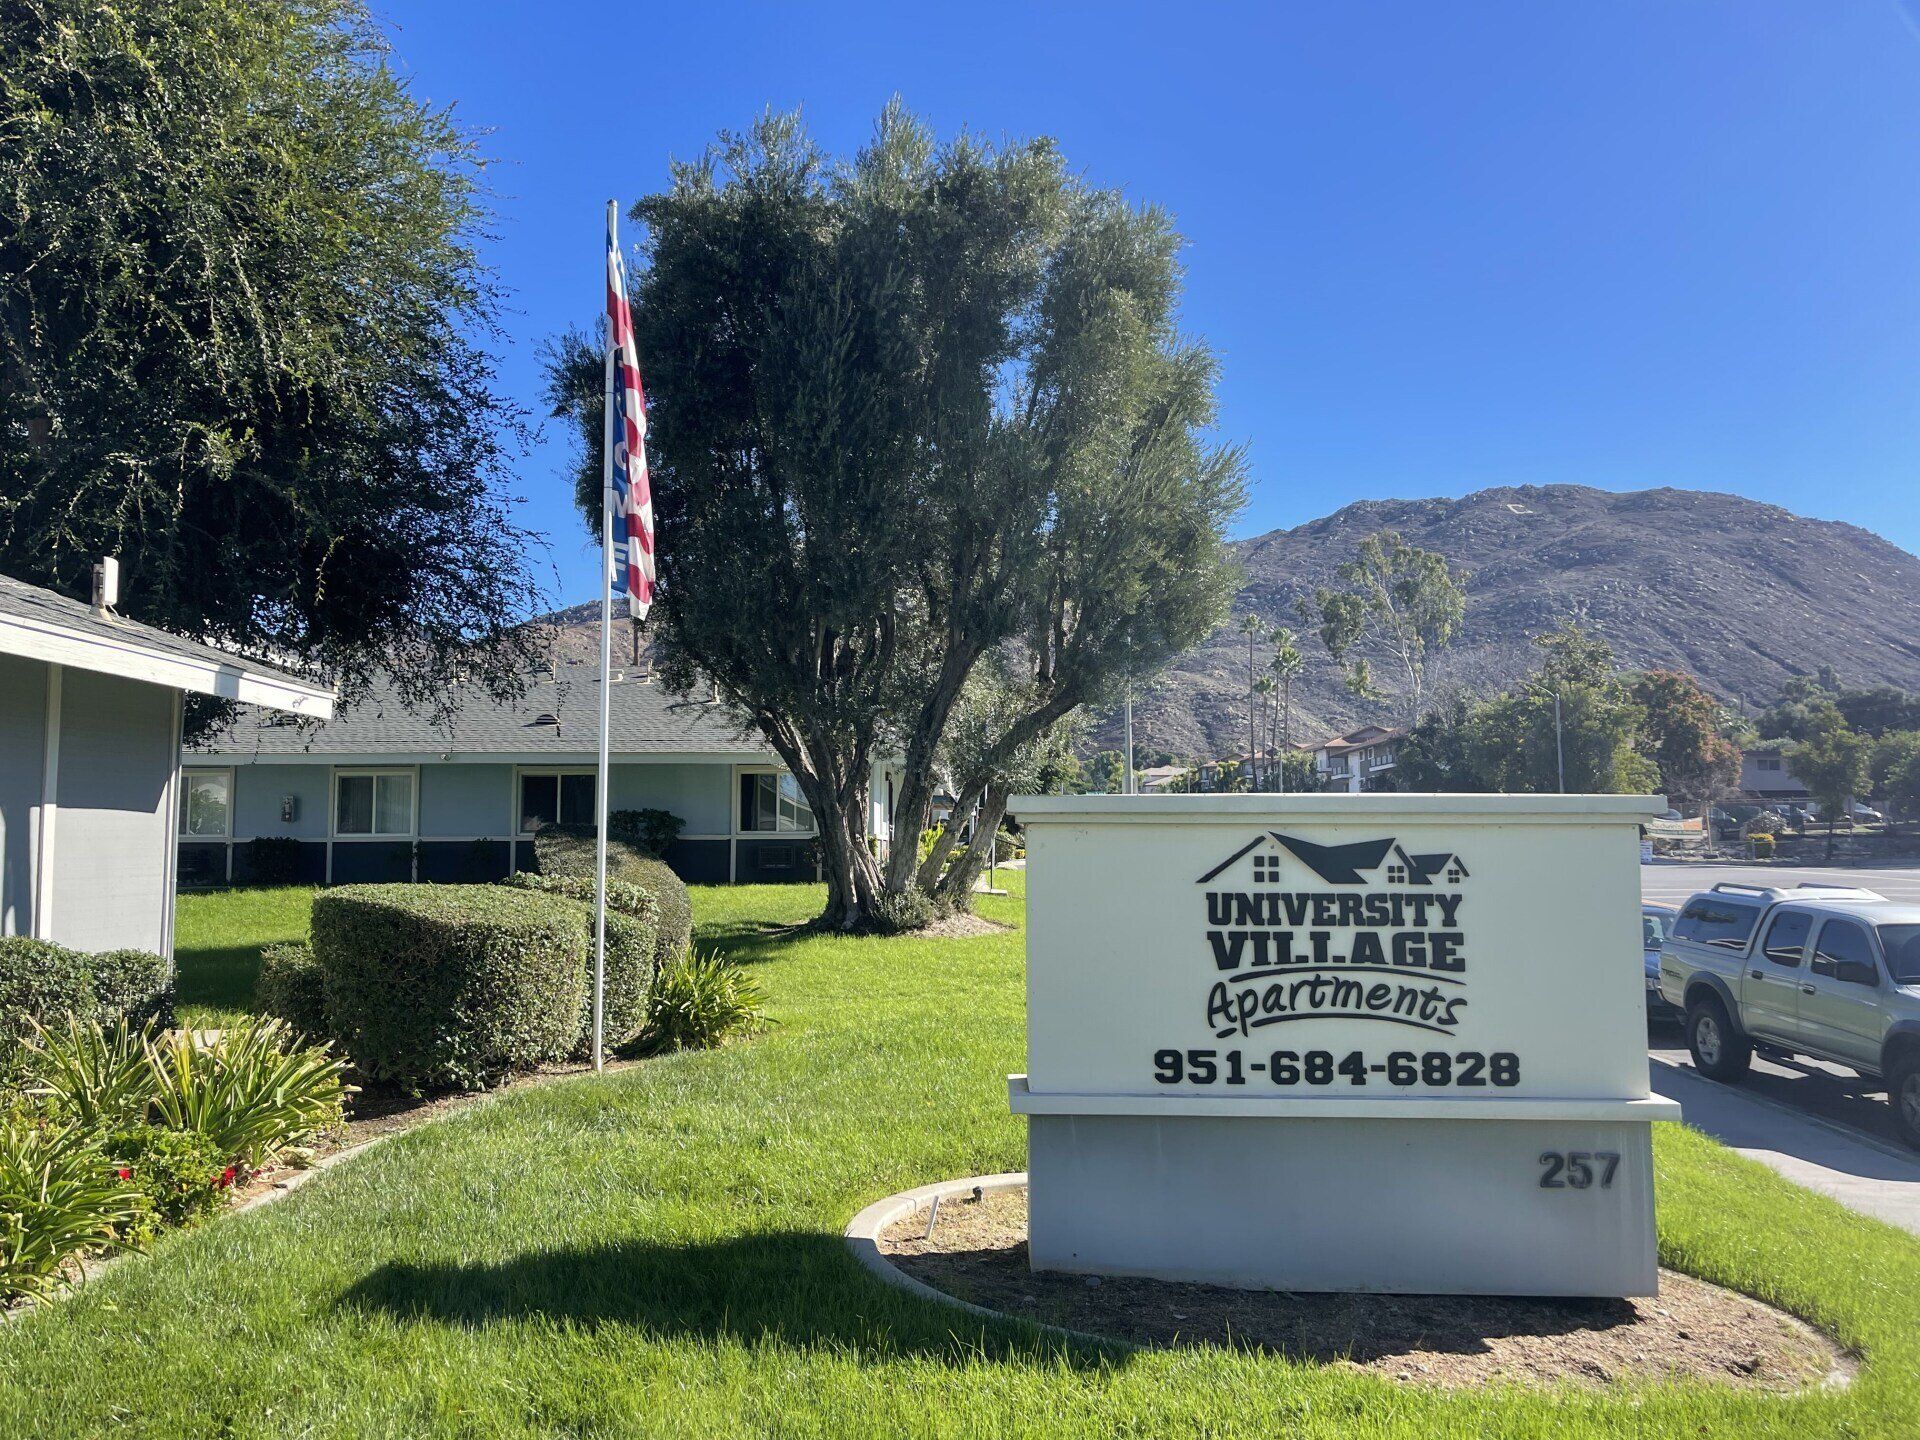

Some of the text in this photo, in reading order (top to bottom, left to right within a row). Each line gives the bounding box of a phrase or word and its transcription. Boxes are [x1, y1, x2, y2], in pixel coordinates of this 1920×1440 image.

[1206, 892, 1462, 927] UNIVERSITY
[1207, 931, 1466, 972] VILLAGE
[1207, 973, 1468, 1038] Apartments
[1153, 1049, 1520, 1087] 951-684-6828
[1539, 1151, 1621, 1190] 257
